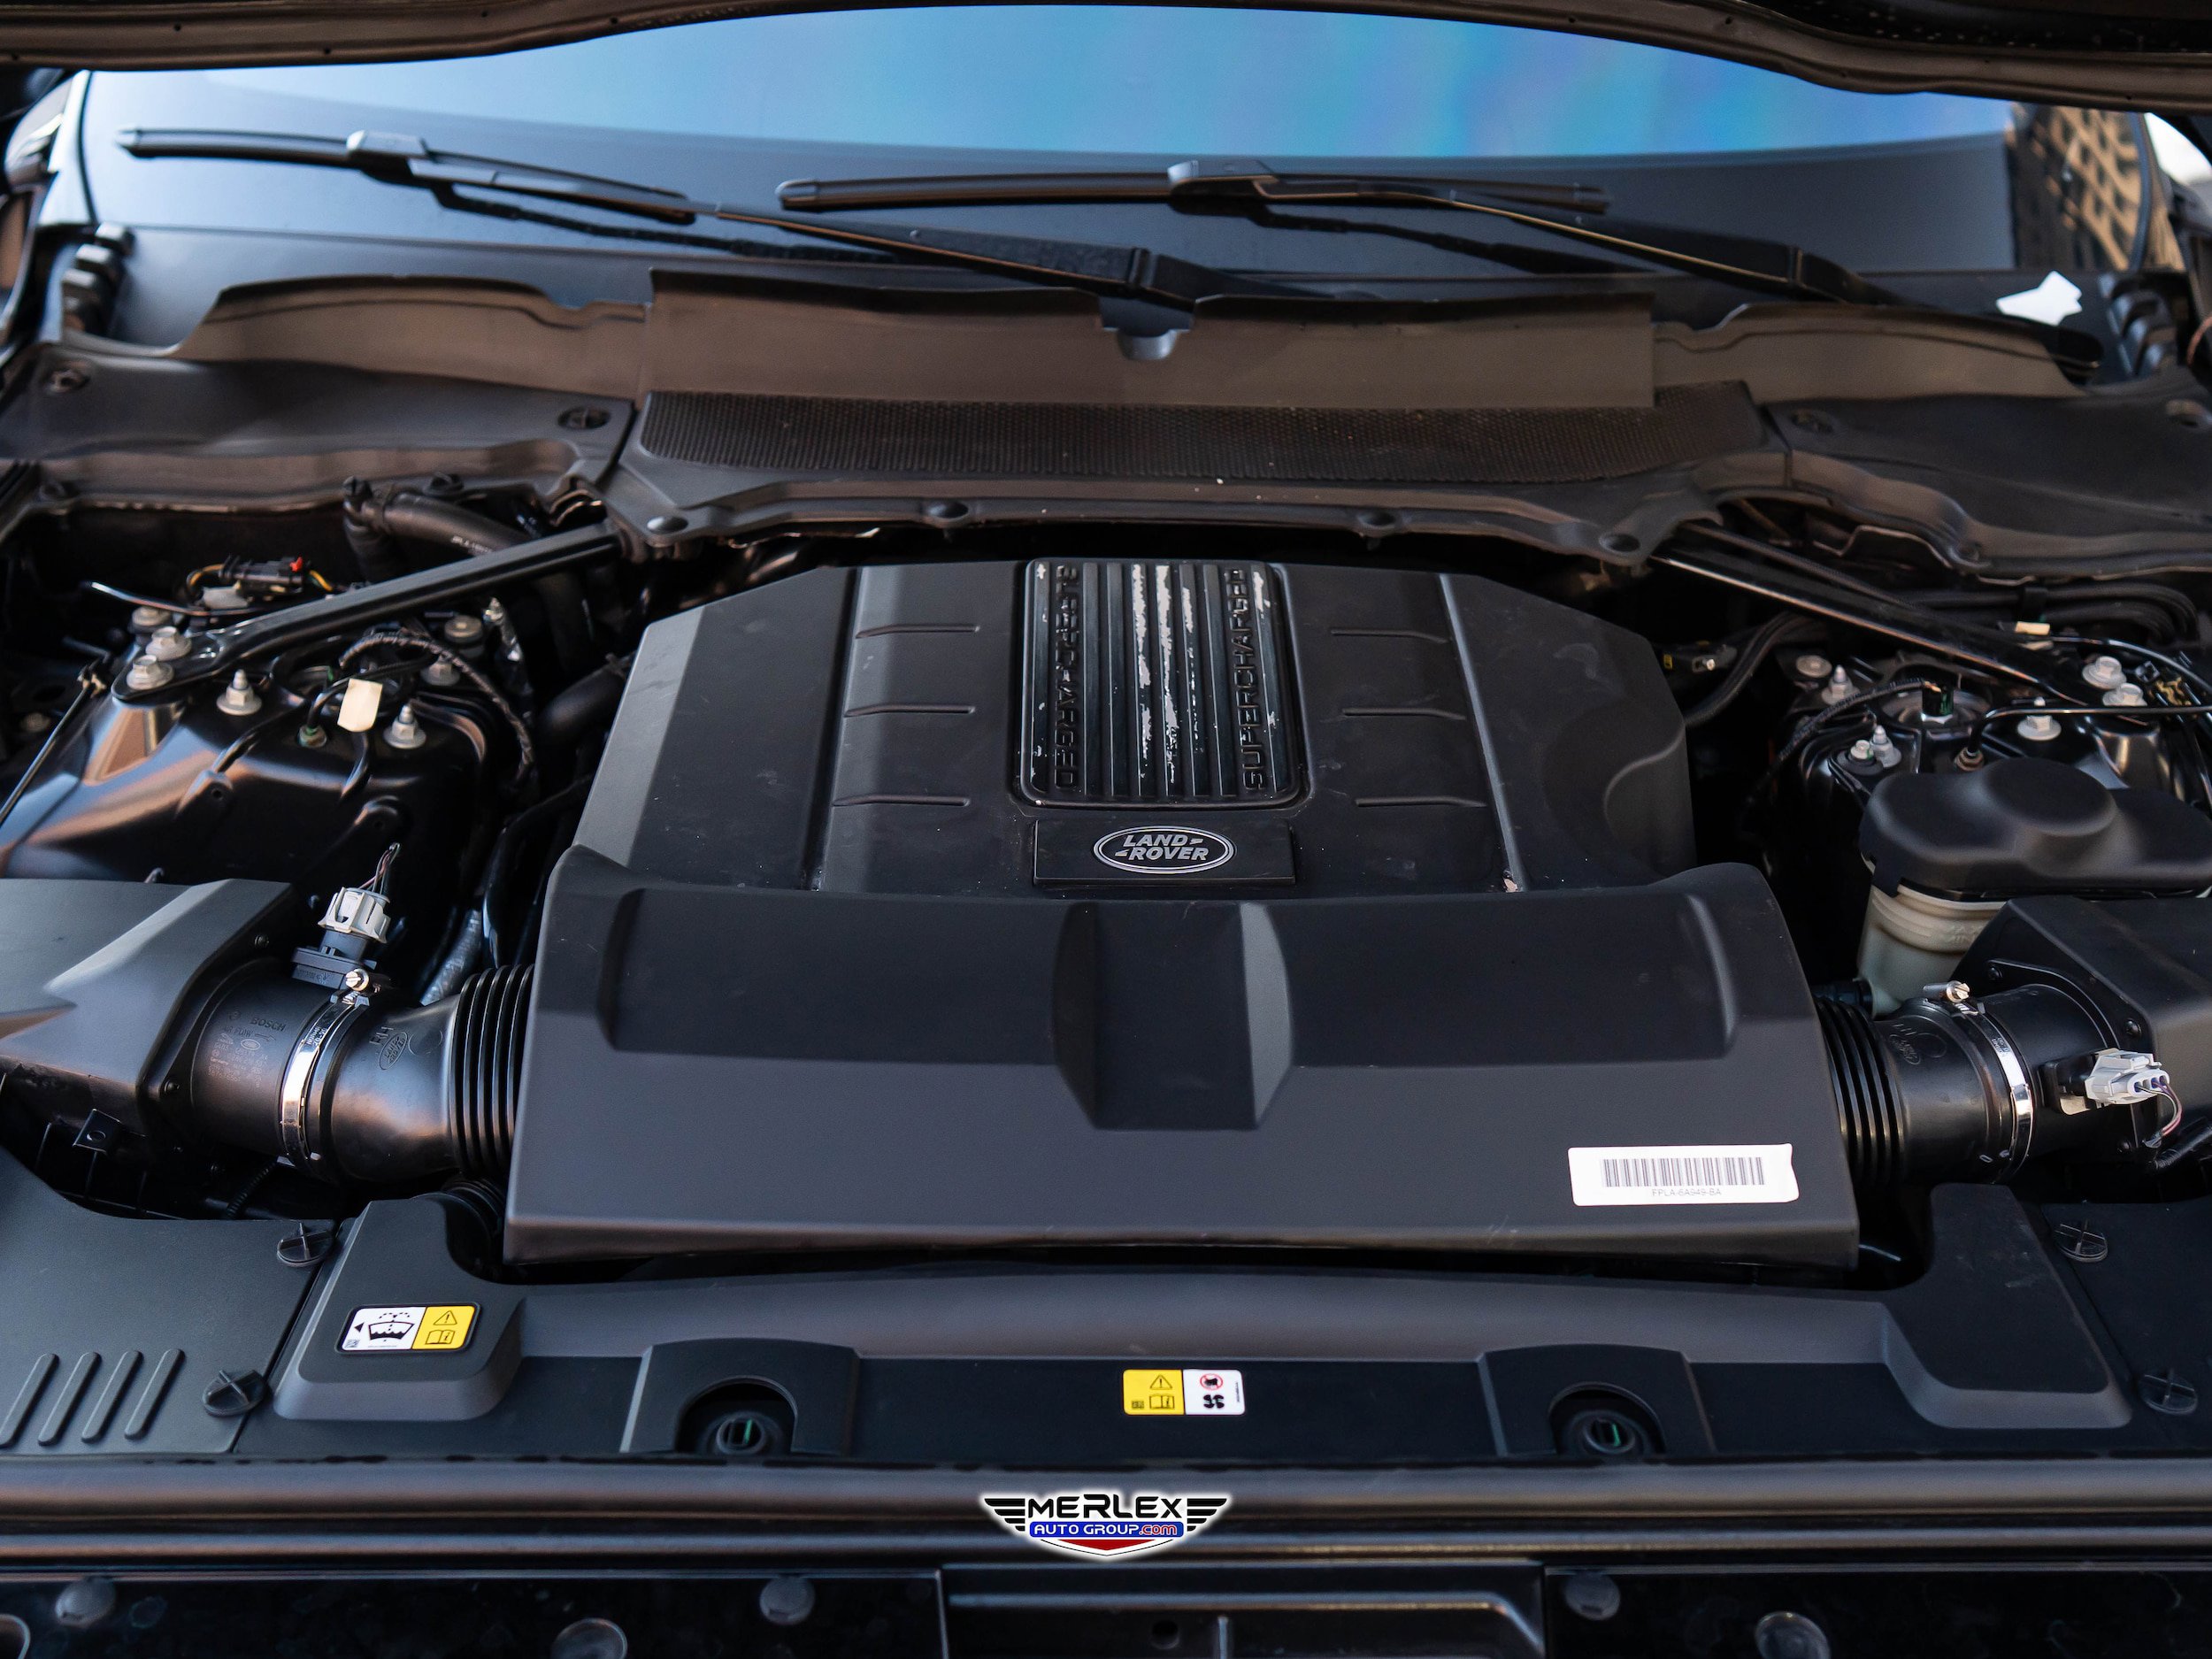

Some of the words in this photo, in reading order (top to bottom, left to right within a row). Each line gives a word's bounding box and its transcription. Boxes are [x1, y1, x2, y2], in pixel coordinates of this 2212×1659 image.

[1224, 568, 1266, 791] SUPERCHARGED
[1122, 833, 1189, 848] LAND
[1126, 847, 1210, 861] ROVER
[249, 1017, 287, 1033] BOSCH
